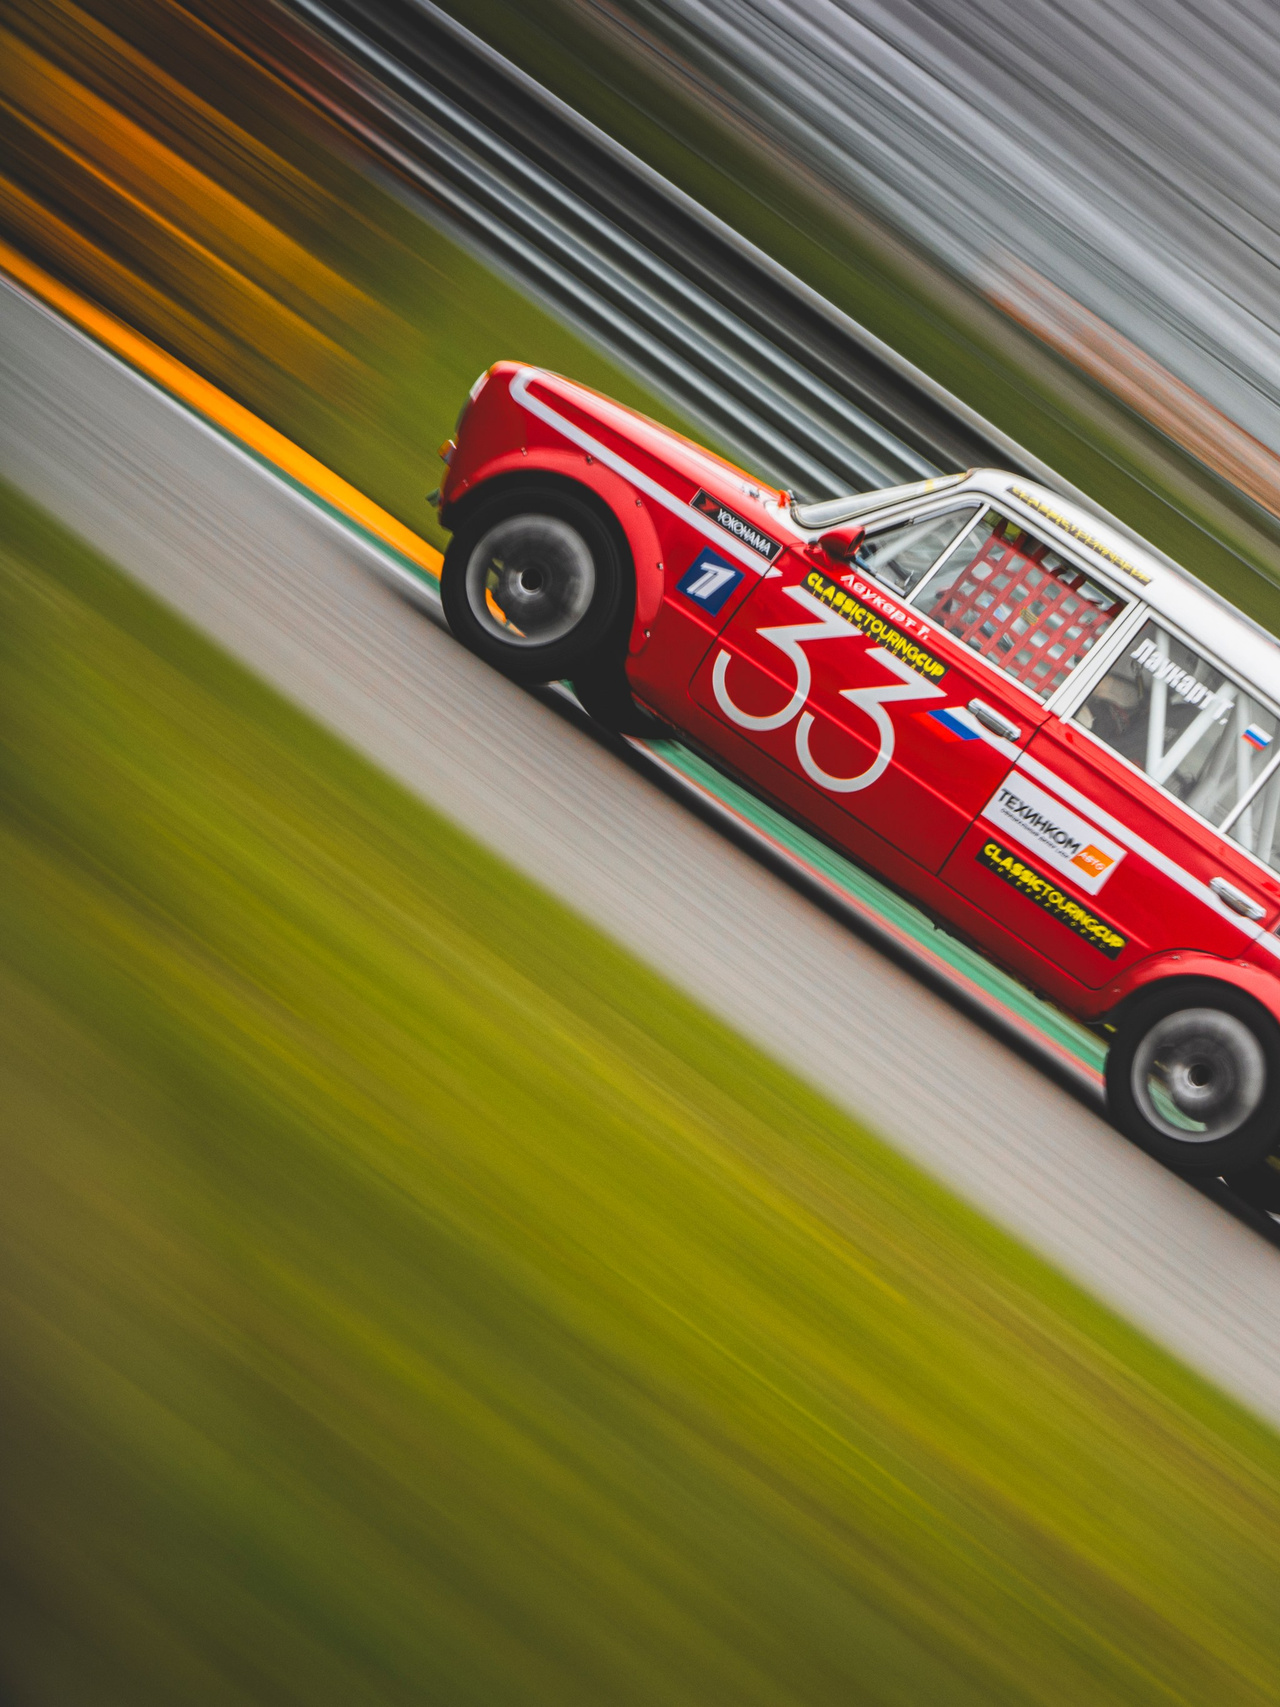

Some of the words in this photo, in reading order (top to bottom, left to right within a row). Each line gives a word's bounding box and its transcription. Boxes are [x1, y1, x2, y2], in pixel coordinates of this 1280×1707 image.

[718, 508, 771, 555] YOKOHAMA
[712, 585, 946, 793] 33
[998, 789, 1082, 854] ТЕХИНКОМ
